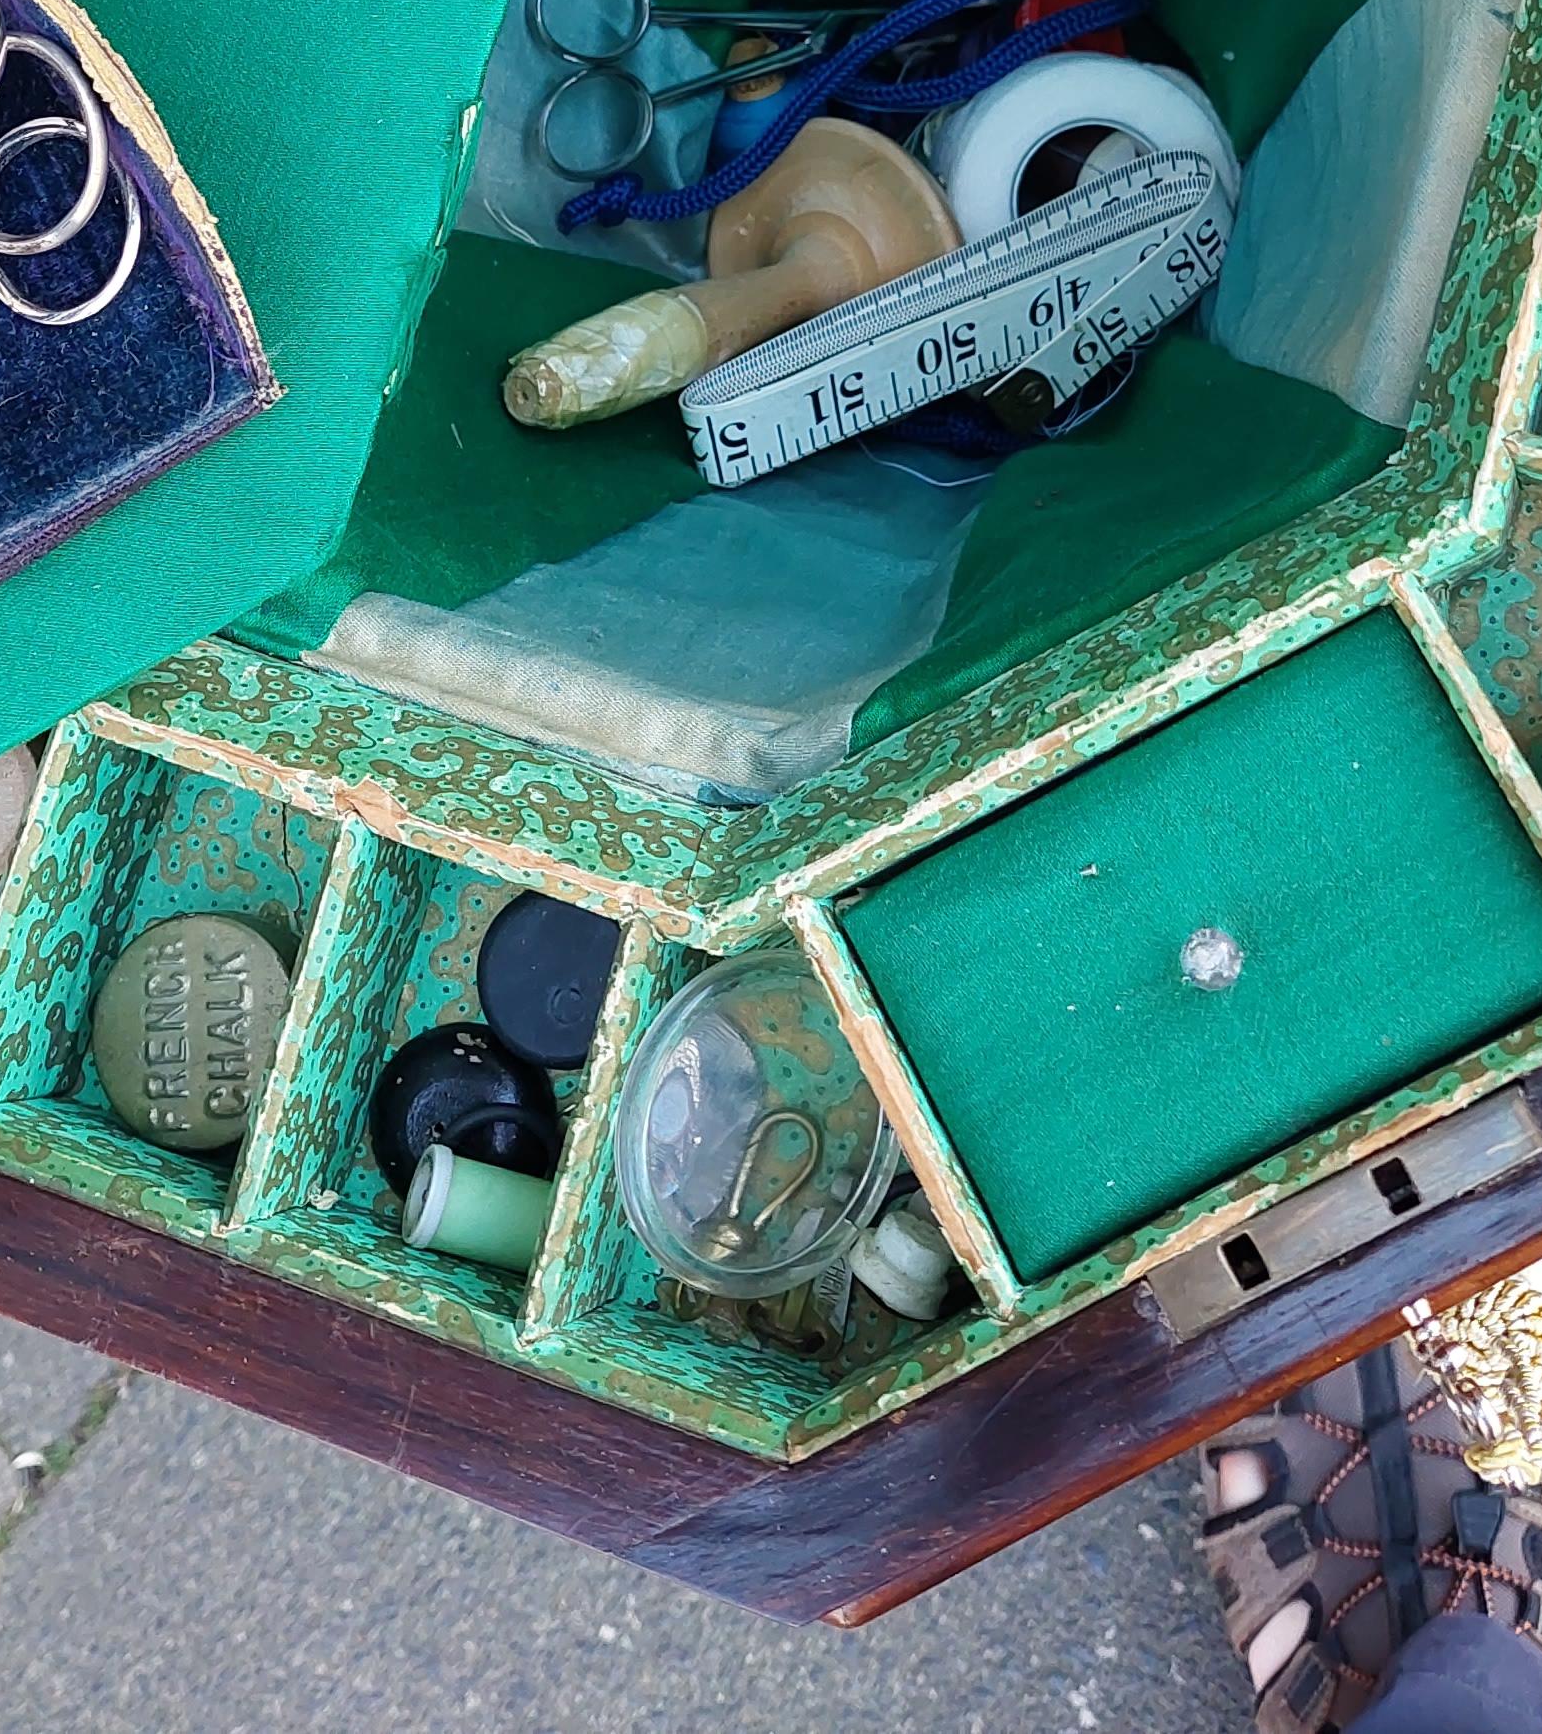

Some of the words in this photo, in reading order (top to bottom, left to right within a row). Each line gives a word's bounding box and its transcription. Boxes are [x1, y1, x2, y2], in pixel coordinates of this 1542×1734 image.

[1029, 276, 1092, 327] 49
[916, 322, 977, 375] 50
[1072, 307, 1129, 365] 59
[803, 371, 865, 426] 51
[143, 941, 192, 1131] FRENCH
[203, 950, 254, 1117] CHALK
